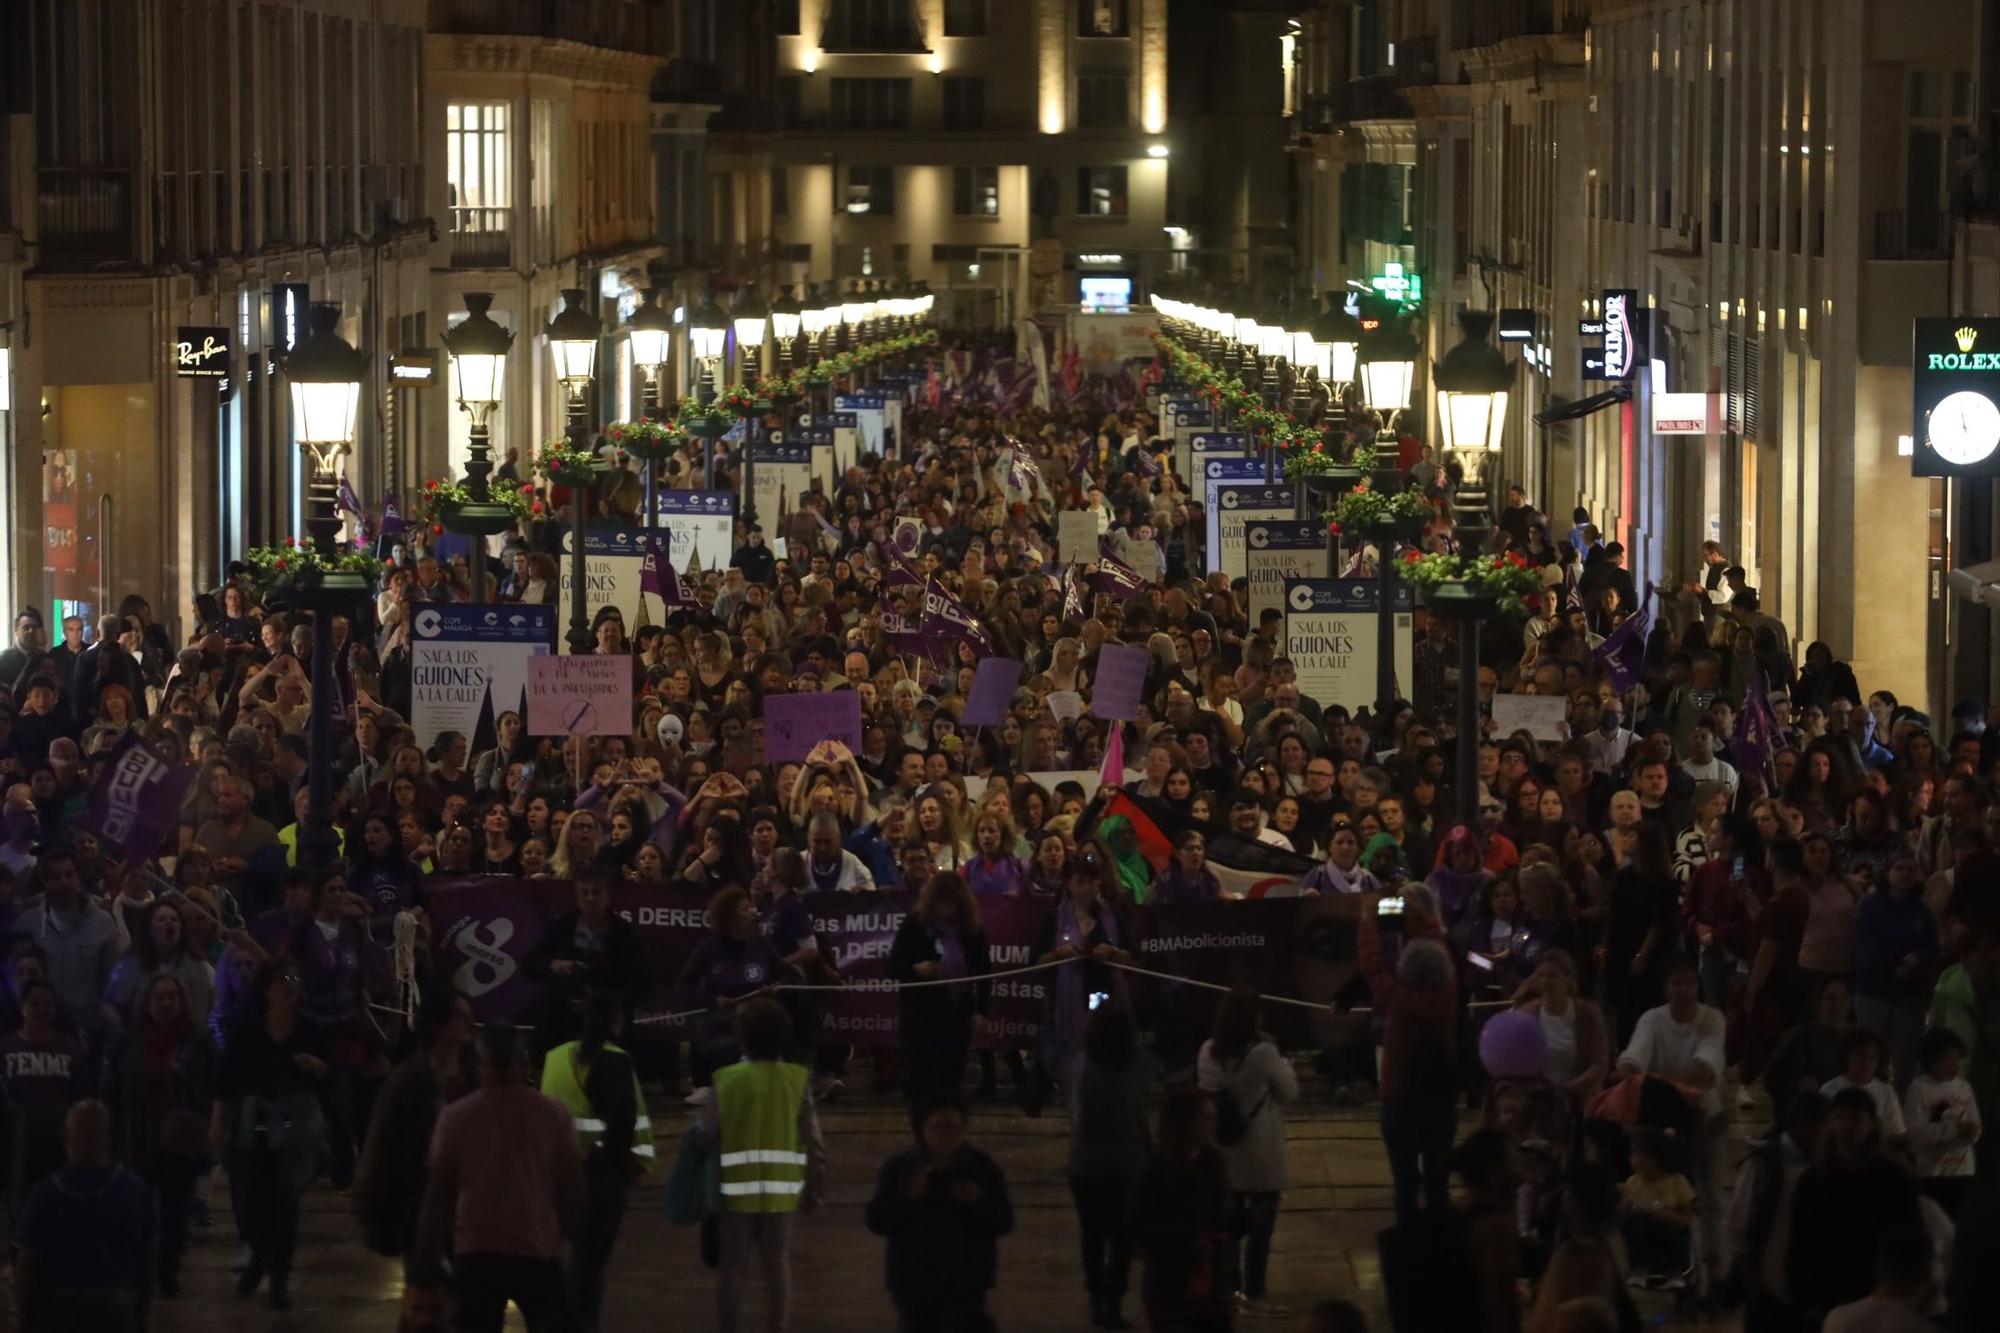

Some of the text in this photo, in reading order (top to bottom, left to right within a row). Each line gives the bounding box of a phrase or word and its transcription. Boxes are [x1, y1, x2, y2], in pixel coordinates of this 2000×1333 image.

[1605, 294, 1623, 377] PRIMOR
[176, 336, 228, 366] Ray-Ban
[1928, 353, 2000, 370] ROLEX
[595, 562, 612, 573] LOS
[561, 575, 616, 591] GONES
[1327, 620, 1348, 634] LOS
[1289, 636, 1353, 654] GUIONES
[456, 649, 478, 664] LOS
[1303, 655, 1316, 668] LA
[414, 666, 484, 687] GUIONES
[416, 688, 424, 701] A
[428, 688, 442, 701] LA
[845, 912, 907, 932] MUJE
[1140, 932, 1265, 952] #8MAbolicionista
[465, 944, 505, 965] marzo
[990, 978, 1046, 999] istas
[985, 1017, 1038, 1039] ujere
